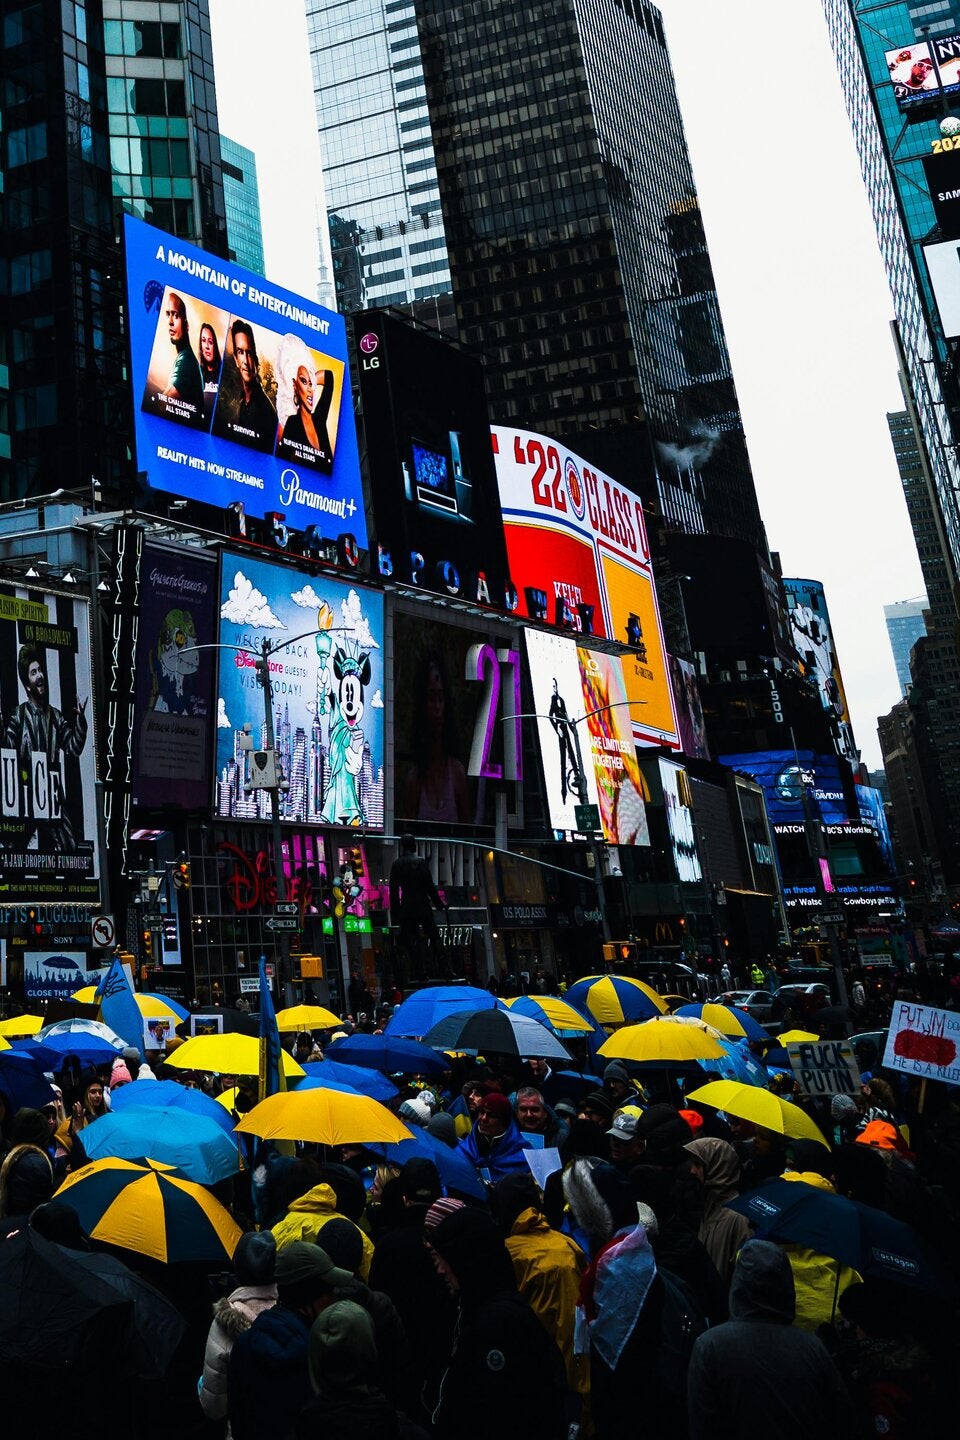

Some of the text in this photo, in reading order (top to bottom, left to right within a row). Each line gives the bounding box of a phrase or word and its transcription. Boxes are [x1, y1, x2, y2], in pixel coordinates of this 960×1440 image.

[156, 245, 330, 336] A MOUNTAIN OF ENTERTAINMENT
[363, 357, 380, 370] LG
[157, 393, 168, 404] THE
[165, 405, 190, 419] ALL STARS
[232, 423, 256, 438] SURVIVOR
[294, 450, 316, 463] ALL STARS
[157, 446, 264, 490] REALITY HITS NOW STREAMING
[279, 468, 357, 520] Paramount+
[583, 467, 637, 553] CLASS
[24, 624, 72, 646] ON BROADWAY!
[286, 645, 308, 659] BACK
[267, 659, 283, 673] tore
[274, 680, 302, 696] ODAY!
[770, 679, 784, 723] 1500
[774, 825, 805, 834] WATCH
[844, 826, 864, 834] World
[9, 854, 56, 869] JAW-DROPPING
[837, 885, 858, 893] rabia
[37, 907, 91, 924] LUGGAGE
[514, 906, 530, 919] POLO
[54, 936, 74, 944] SONY
[27, 989, 52, 997] CLOSE
[54, 989, 69, 997] THE
[899, 1004, 924, 1030] PUT
[798, 1042, 849, 1068] FUCK
[893, 1054, 906, 1069] HE
[913, 1059, 922, 1073] IS
[924, 1063, 932, 1076] A
[801, 1068, 856, 1094] PUTIN
[879, 1252, 916, 1269] octagon
